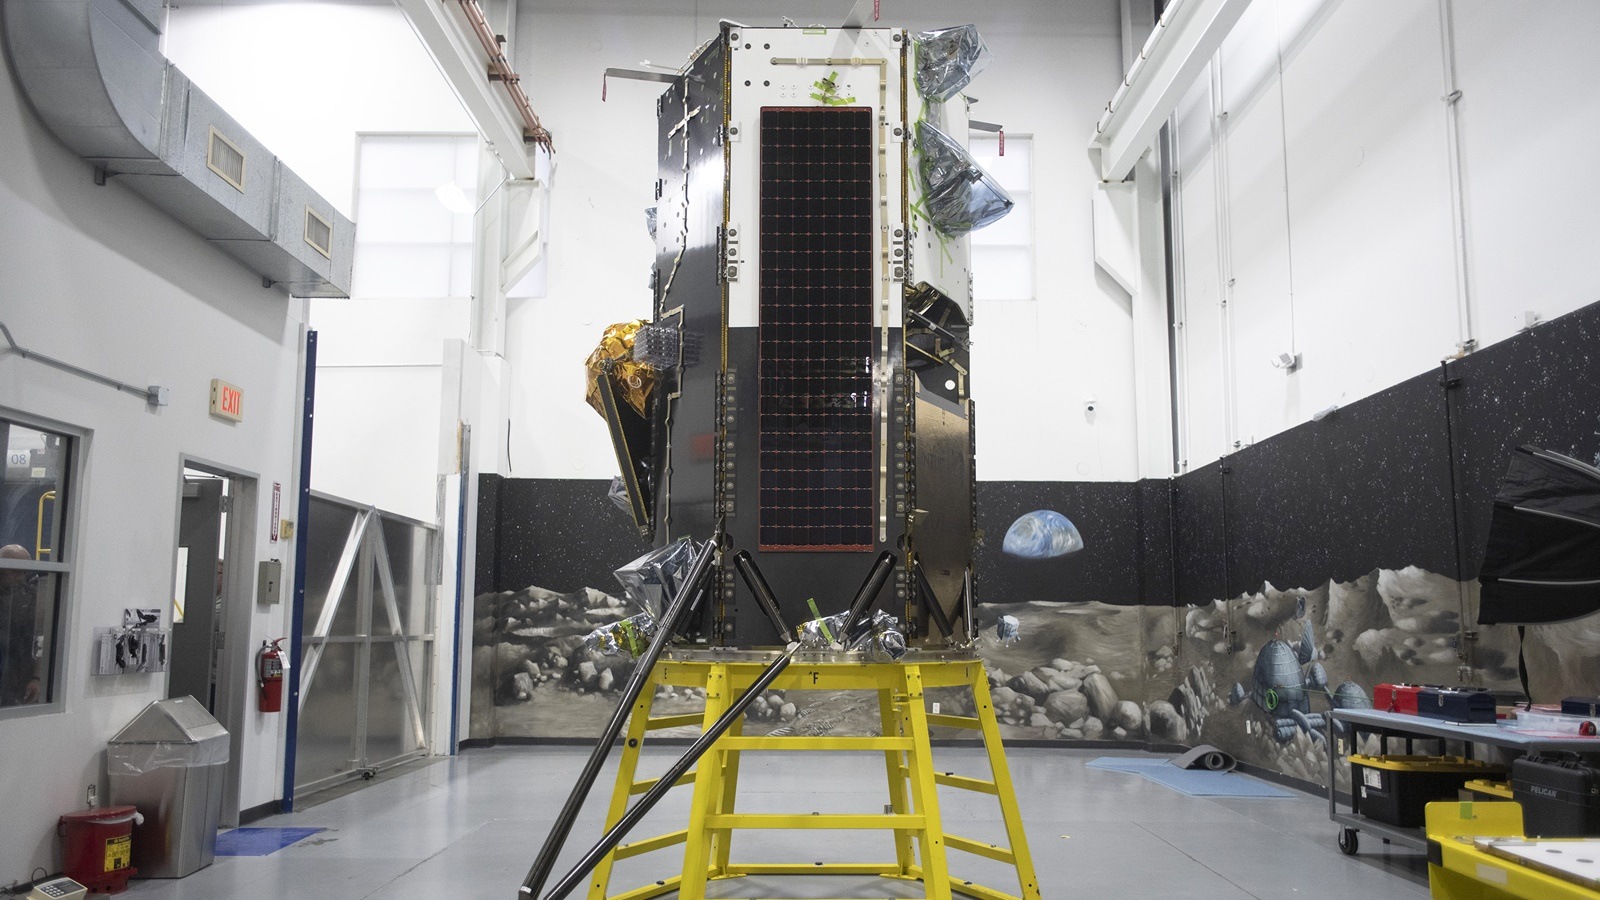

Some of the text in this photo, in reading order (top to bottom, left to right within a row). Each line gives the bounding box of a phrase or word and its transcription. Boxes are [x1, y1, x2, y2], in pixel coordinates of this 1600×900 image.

[222, 386, 241, 415] EXIT
[11, 454, 26, 465] 08
[813, 671, 819, 685] F
[1530, 785, 1557, 798] PELICAN
